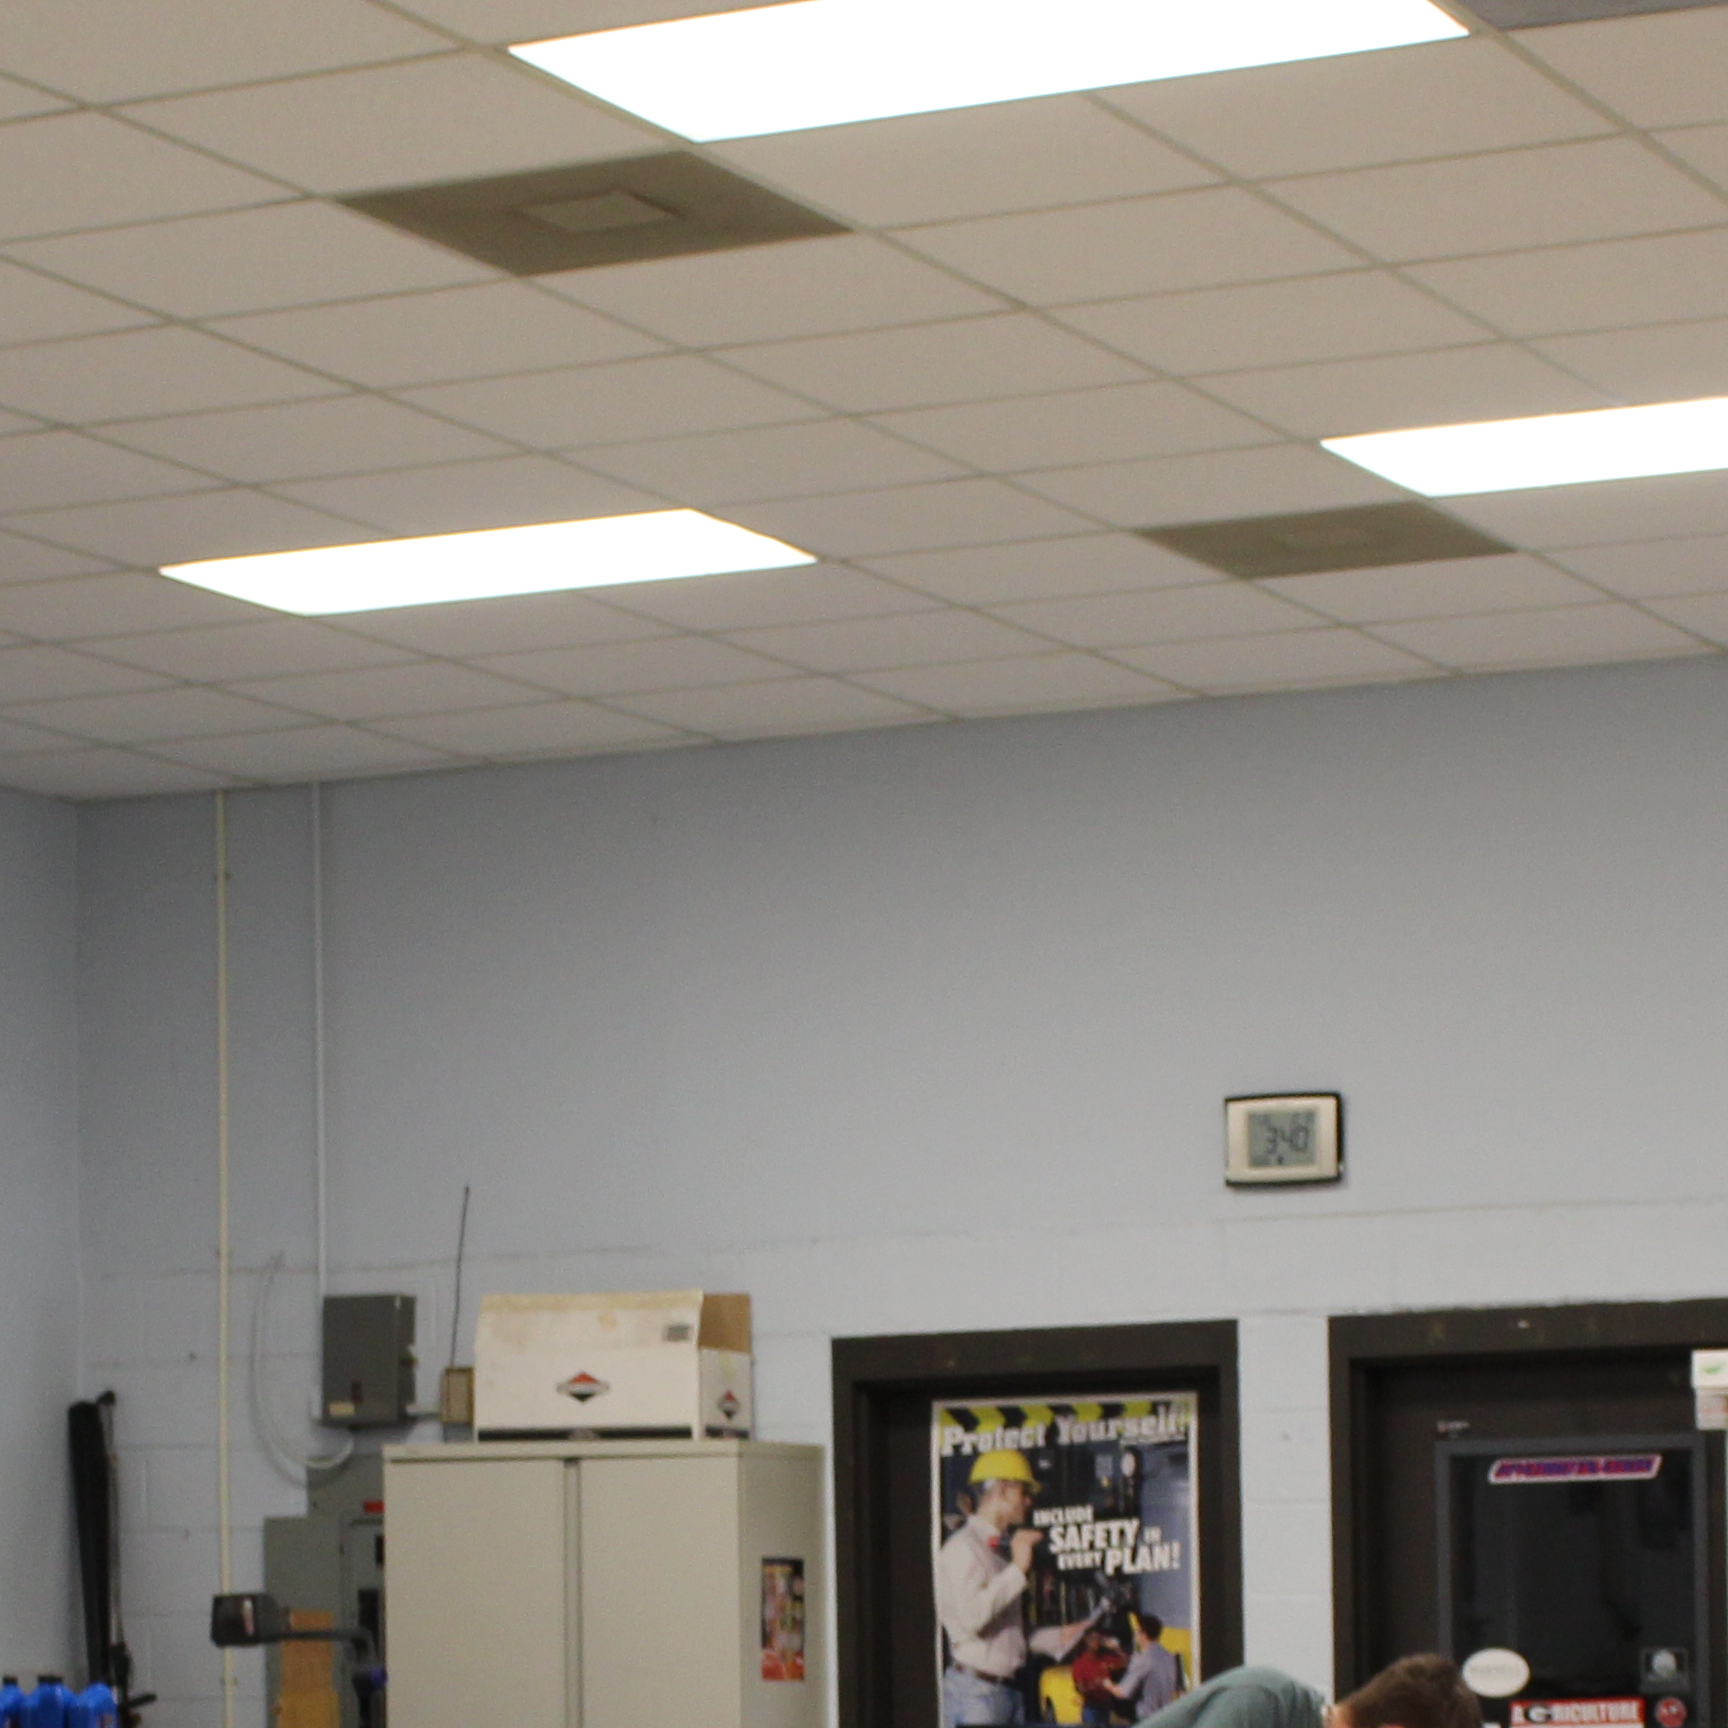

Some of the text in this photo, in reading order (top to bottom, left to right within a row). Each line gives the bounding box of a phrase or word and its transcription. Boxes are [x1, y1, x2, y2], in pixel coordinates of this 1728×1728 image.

[941, 1422, 1047, 1457] Protect
[1033, 1504, 1094, 1527] INCLUDE
[1049, 1518, 1140, 1555] SAFETY
[1058, 1542, 1181, 1577] EVERY PLAN!
